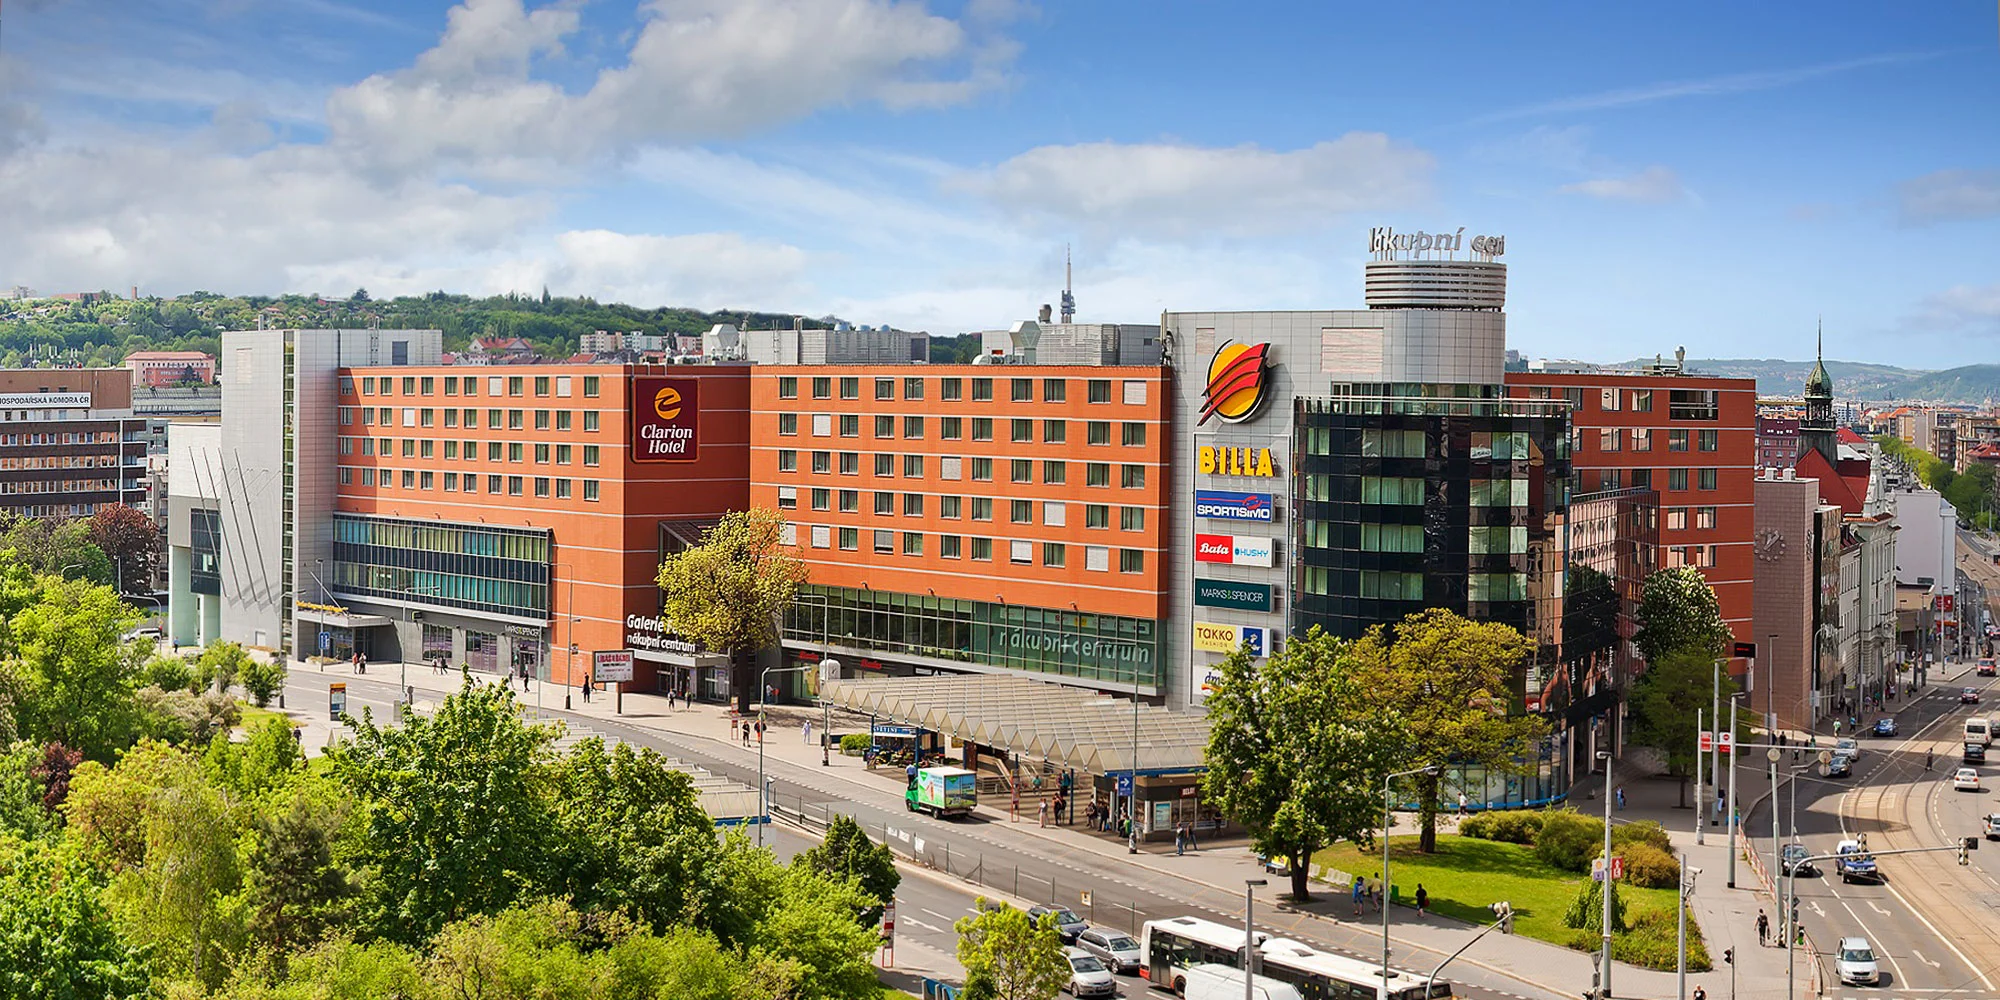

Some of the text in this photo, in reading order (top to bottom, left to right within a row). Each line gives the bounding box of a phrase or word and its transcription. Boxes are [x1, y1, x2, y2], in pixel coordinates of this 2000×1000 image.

[641, 423, 693, 440] Clarion
[648, 438, 686, 454] Hotel
[1199, 445, 1275, 478] BILLA
[1199, 542, 1230, 555] Bata
[1239, 547, 1269, 559] HUSKY
[626, 613, 664, 632] Galerie
[626, 632, 696, 653] nákupní centrum
